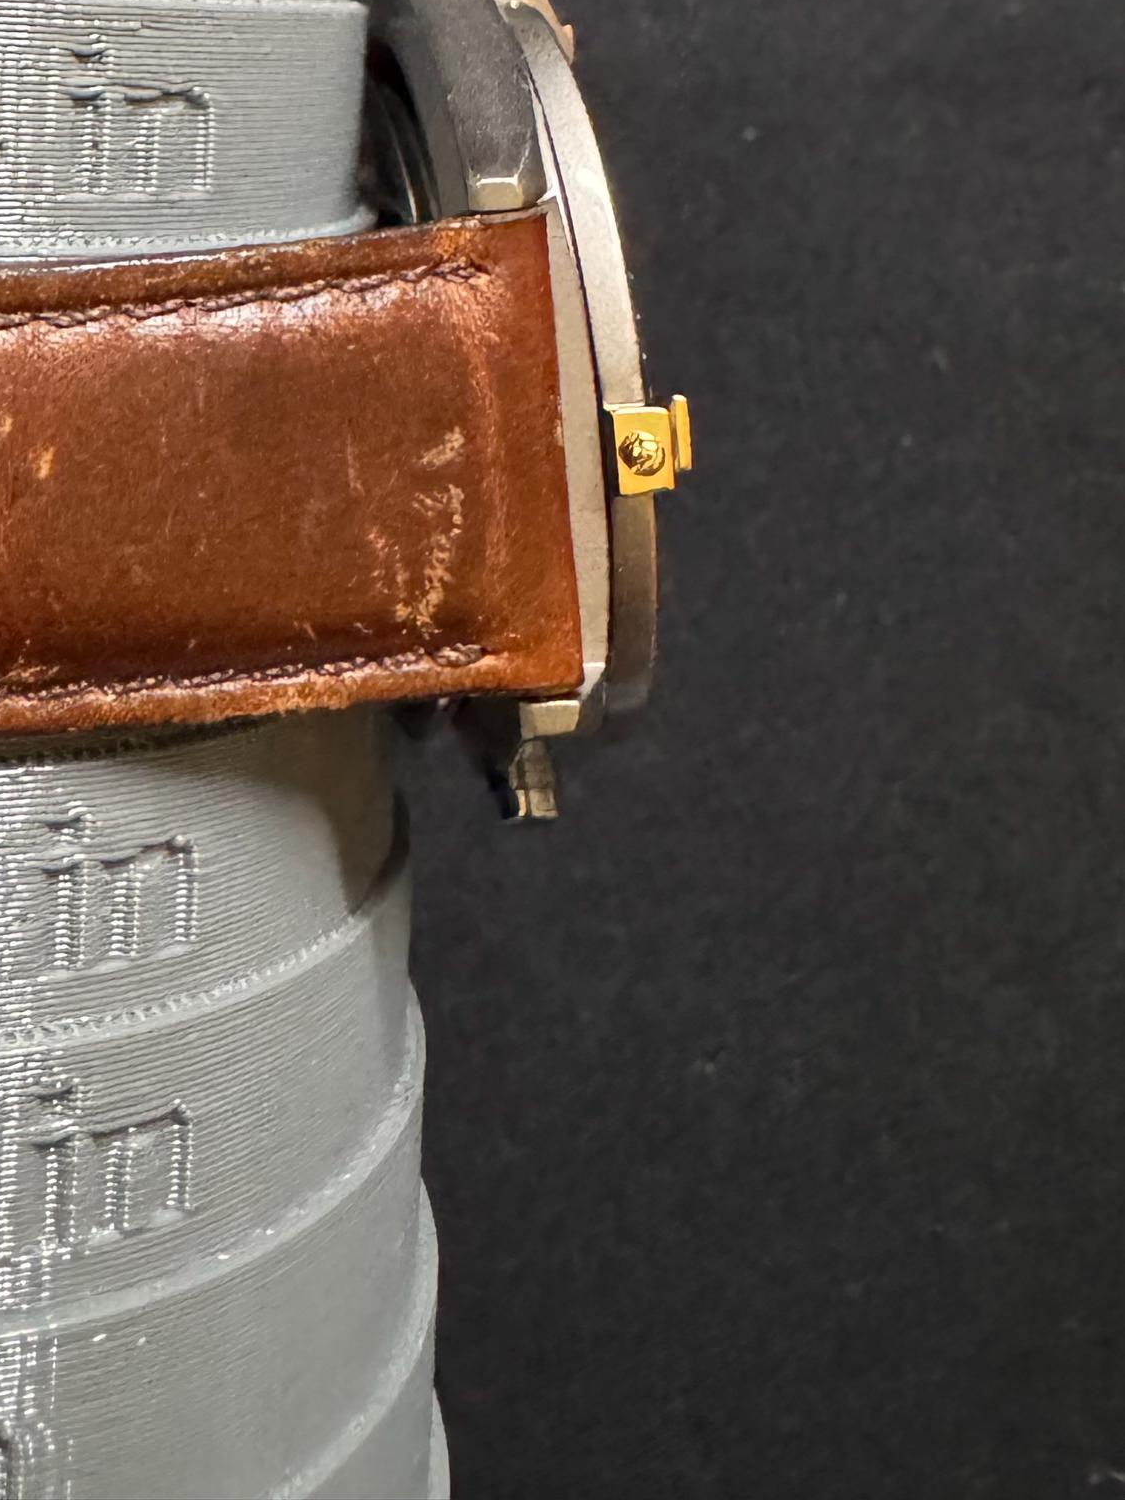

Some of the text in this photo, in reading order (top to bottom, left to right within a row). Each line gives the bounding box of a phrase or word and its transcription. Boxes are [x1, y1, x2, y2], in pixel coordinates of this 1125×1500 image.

[70, 38, 217, 205] in
[43, 804, 201, 972] in
[35, 1078, 195, 1260] in
